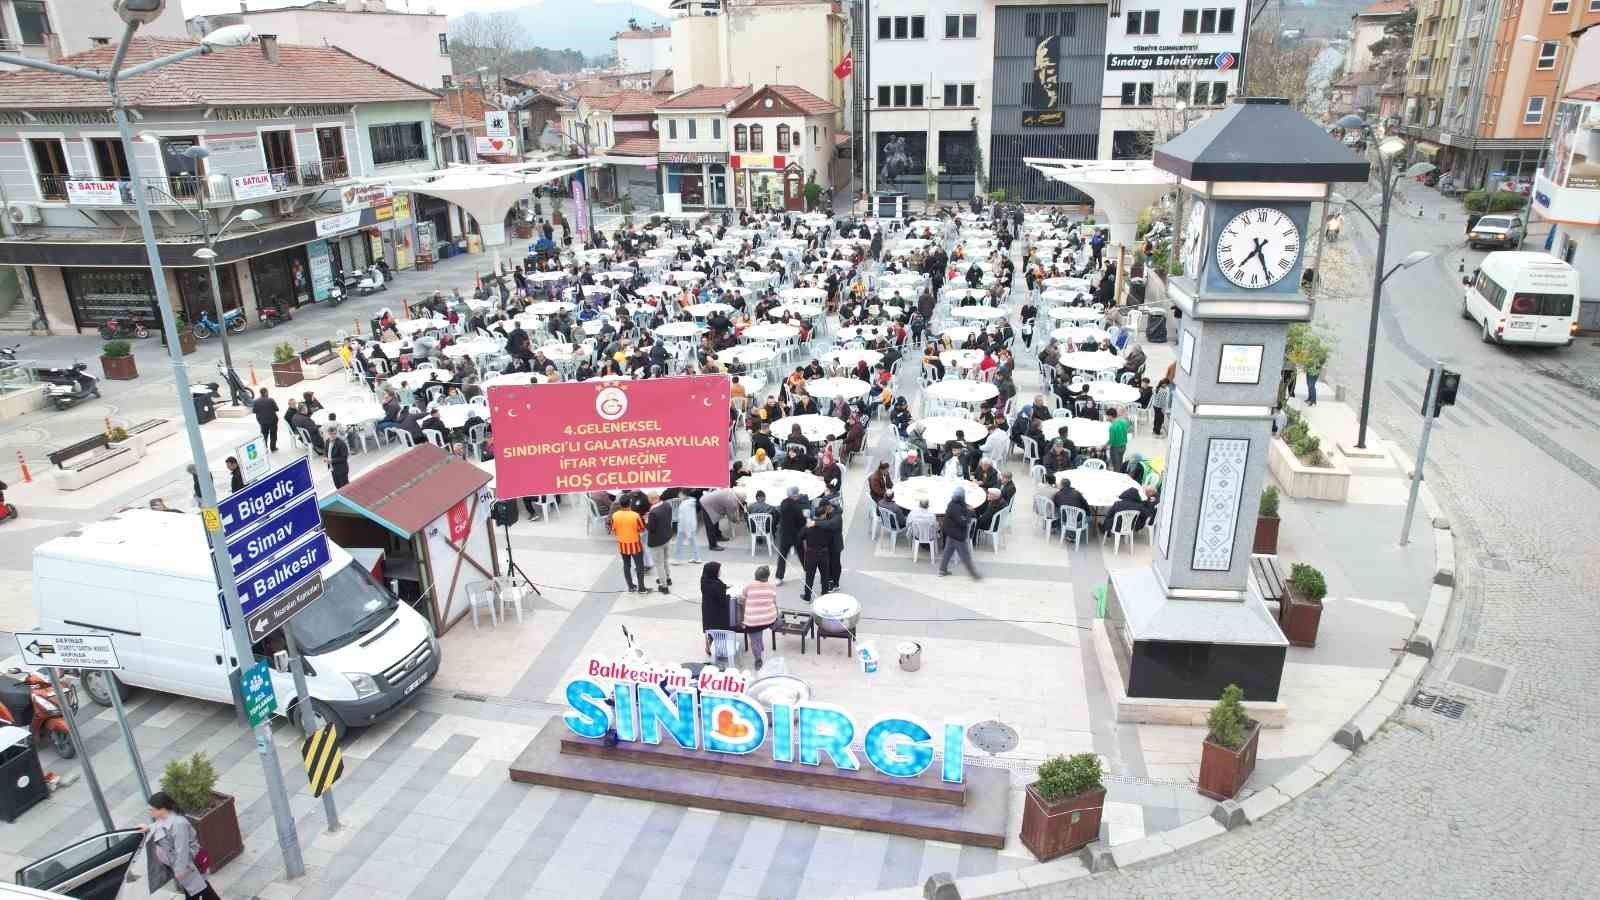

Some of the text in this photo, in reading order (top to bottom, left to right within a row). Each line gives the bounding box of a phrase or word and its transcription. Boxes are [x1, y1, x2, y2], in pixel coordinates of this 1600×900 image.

[1111, 55, 1213, 68] Sındırgı Belediyesi
[78, 182, 116, 191] SATILIK
[242, 175, 270, 187] SATILIK
[563, 420, 662, 435] 4.GELENEKSEL
[503, 435, 720, 458] SINDIRGI'LI GALATASARAYLILAR
[560, 452, 668, 470] İFTAR YEMEĞİNE
[556, 465, 673, 490] HOŞ GELDİNİZ
[238, 479, 294, 521] Bigadiç
[247, 520, 294, 560] Simav
[253, 547, 318, 598] Balıkesir
[588, 659, 746, 694] Balıkesir'in Kalbi
[563, 679, 963, 784] SINDIRGI
